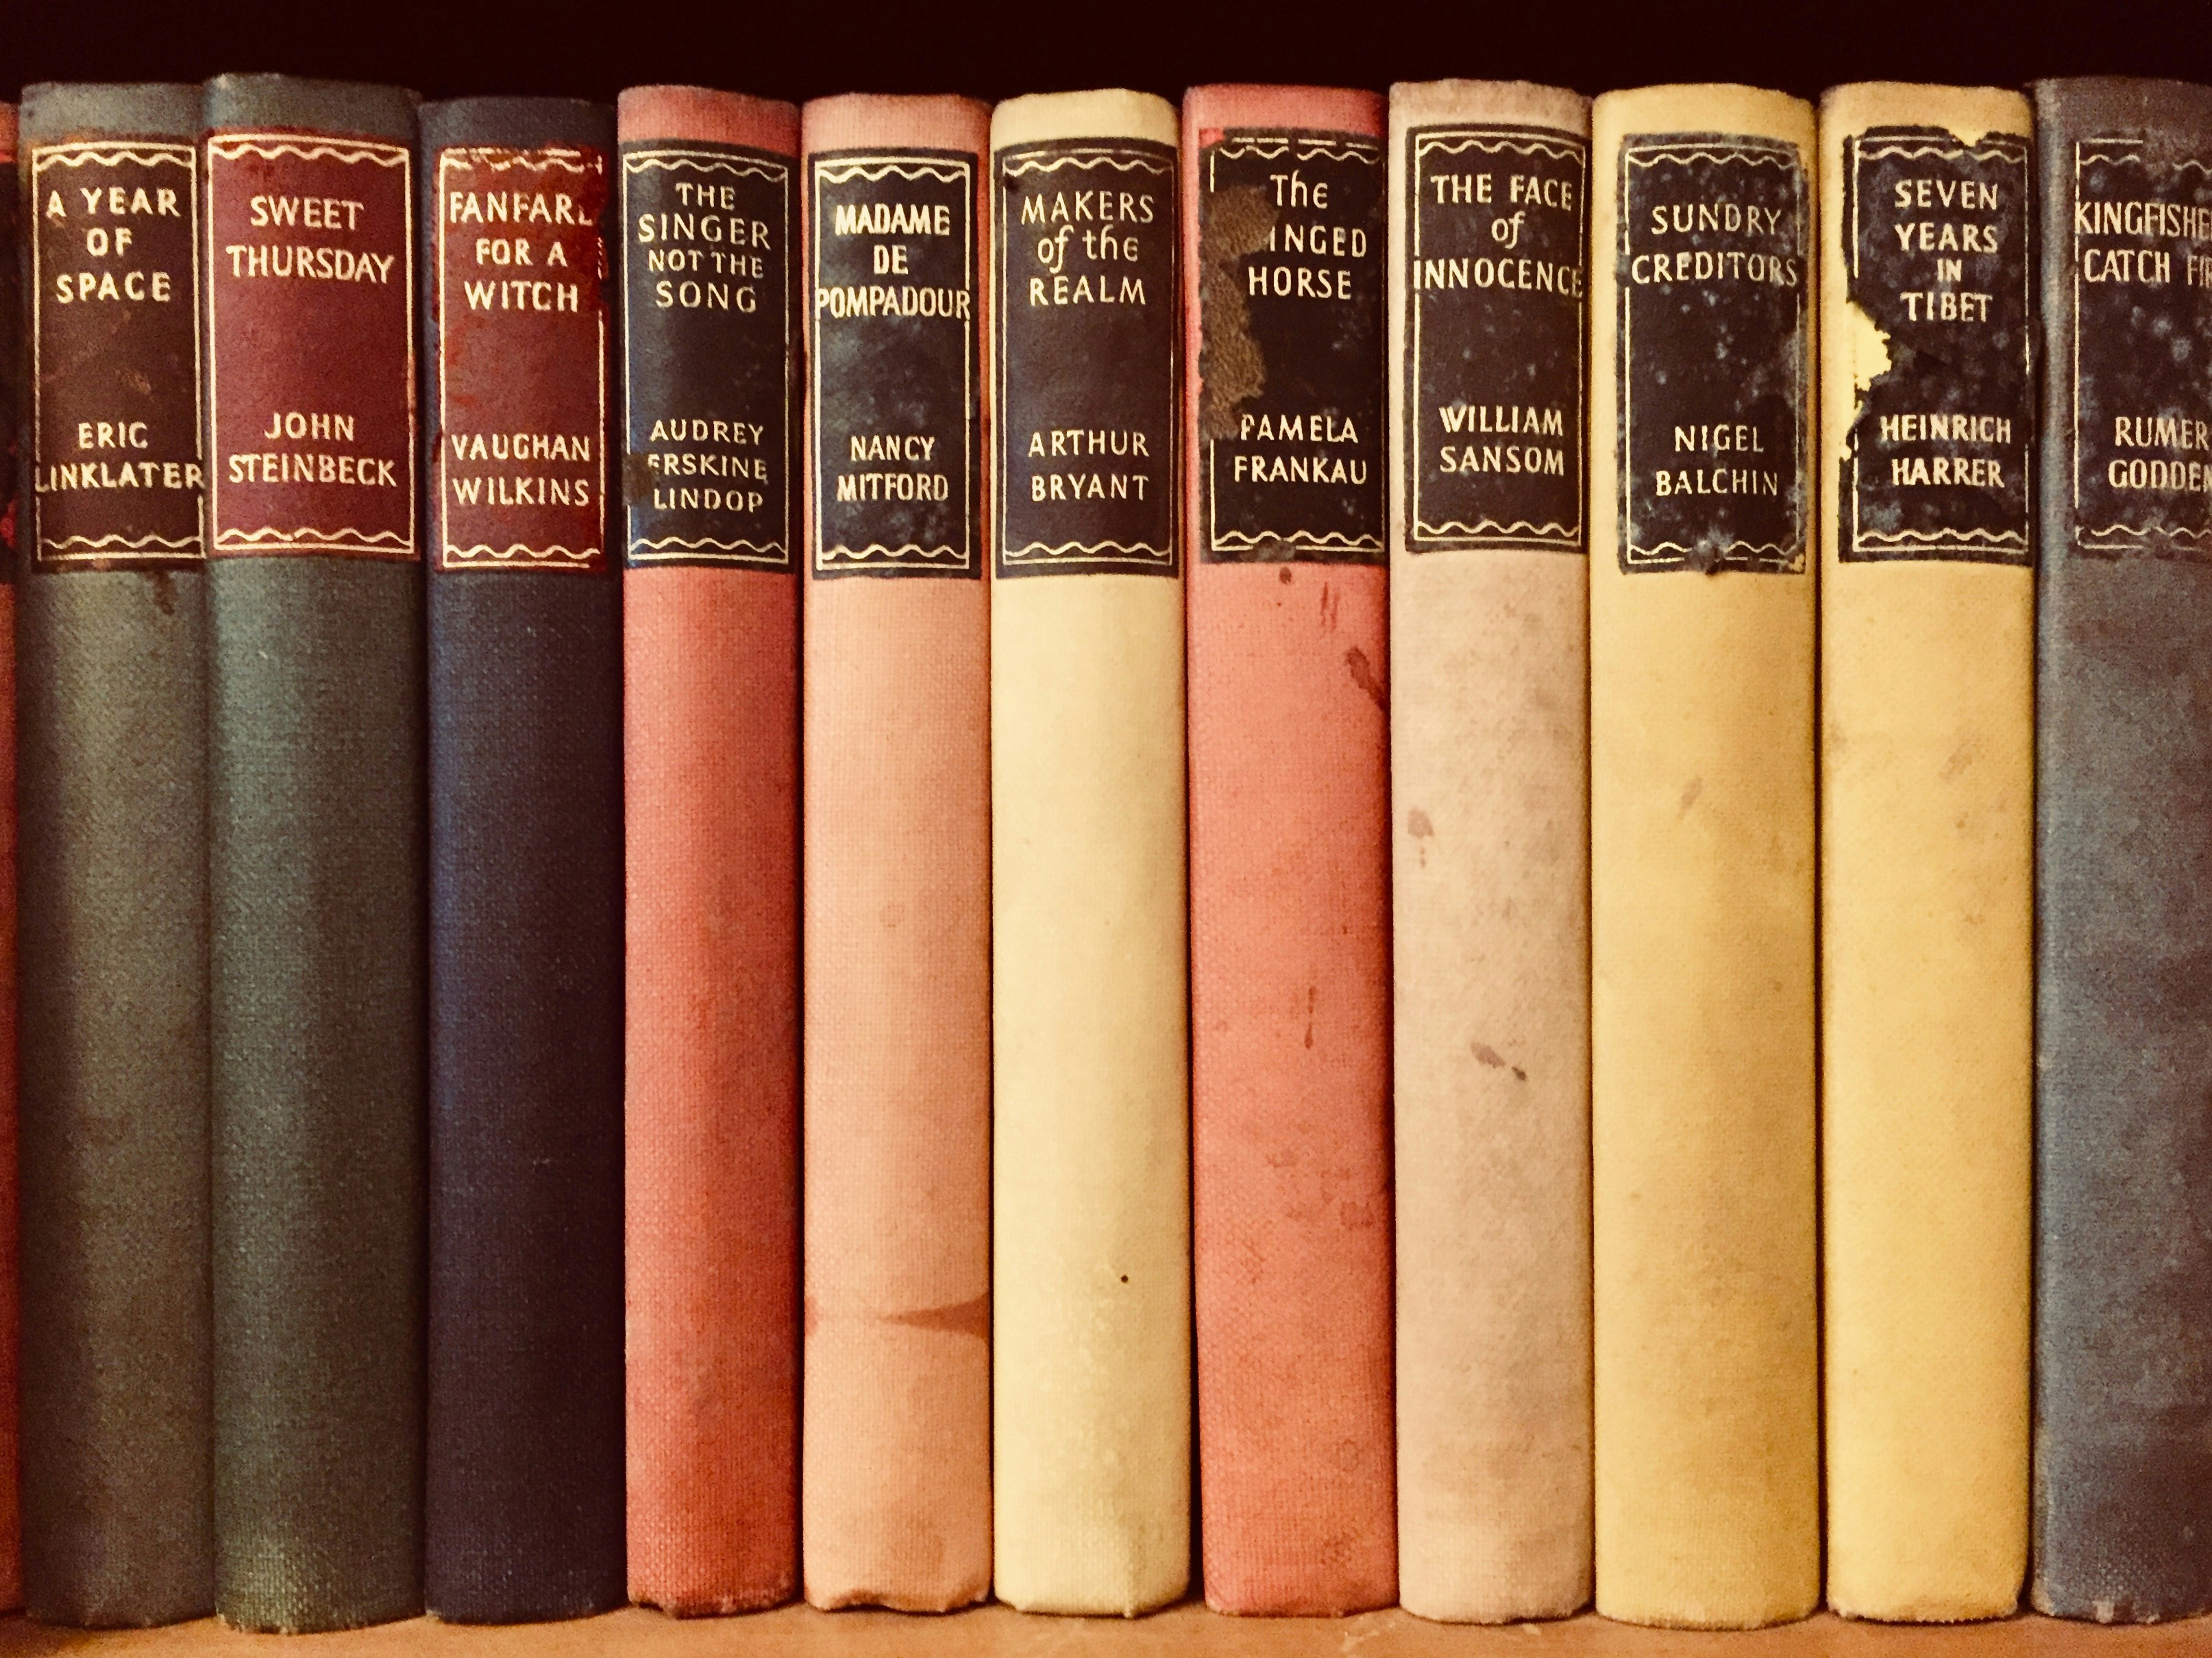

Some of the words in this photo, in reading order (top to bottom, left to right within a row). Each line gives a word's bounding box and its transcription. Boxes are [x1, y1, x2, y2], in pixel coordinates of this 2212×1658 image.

[46, 193, 65, 219] A
[81, 187, 181, 218] YEAR
[676, 182, 736, 210] THE
[1270, 169, 1328, 209] The
[1431, 173, 1493, 205] THE
[1509, 175, 1573, 211] FACE
[1894, 179, 1999, 210] SEVEN
[249, 195, 365, 231] SWEET
[835, 203, 950, 237] MADAME
[1020, 190, 1155, 225] MAKERS
[1651, 203, 1782, 236] SUNDRY
[86, 227, 133, 257] OF
[639, 213, 772, 250] SINGER
[1269, 223, 1366, 258] INGED
[1491, 212, 1524, 249] of
[1895, 223, 1999, 253] YEARS
[225, 245, 396, 284] THURSDAY
[476, 238, 533, 265] FOR
[548, 242, 568, 267] A
[648, 249, 703, 273] NOT
[711, 252, 765, 278] THE
[874, 245, 909, 275] DE
[1037, 225, 1074, 273] of
[1081, 227, 1139, 262] the
[1413, 259, 1583, 298] INNOCENCE
[1632, 252, 1797, 287] CREDITORS
[1937, 262, 1963, 282] IN
[2084, 249, 2170, 283] CATCH
[56, 271, 172, 304] SPACE
[464, 280, 578, 312] WITCH
[654, 281, 757, 313] SONG
[1029, 275, 1146, 306] REALM
[1249, 266, 1351, 299] HORSE
[815, 286, 971, 320] POMPADOUR
[1900, 291, 1993, 323] TIBET
[77, 421, 149, 450] ERIC
[264, 412, 355, 441] JOHN
[650, 419, 763, 445] AUDREY
[1240, 414, 1358, 444] PAMELA
[1438, 404, 1564, 437] WILLIAM
[1880, 414, 2012, 445] HEINRICH
[2115, 417, 2209, 451] RUMER
[452, 434, 591, 462] VAUGHAN
[850, 434, 935, 461] NANCY
[1028, 430, 1148, 458] ARTHUR
[1673, 425, 1765, 453] NIGEL
[228, 454, 397, 487] STEINBECK
[648, 453, 768, 480] ERSKINE
[1234, 455, 1367, 485] FRANKAU
[1439, 445, 1564, 476] SANSOM
[1891, 458, 2005, 489] HARRER
[2109, 458, 2212, 493] GODDEN
[35, 460, 204, 493] LINKLATER
[837, 473, 949, 503] MITFORD
[1031, 473, 1150, 502] BRYANT
[1656, 468, 1778, 497] BALCHIN
[452, 478, 590, 507] WILKINS
[654, 488, 763, 512] LINDOP
